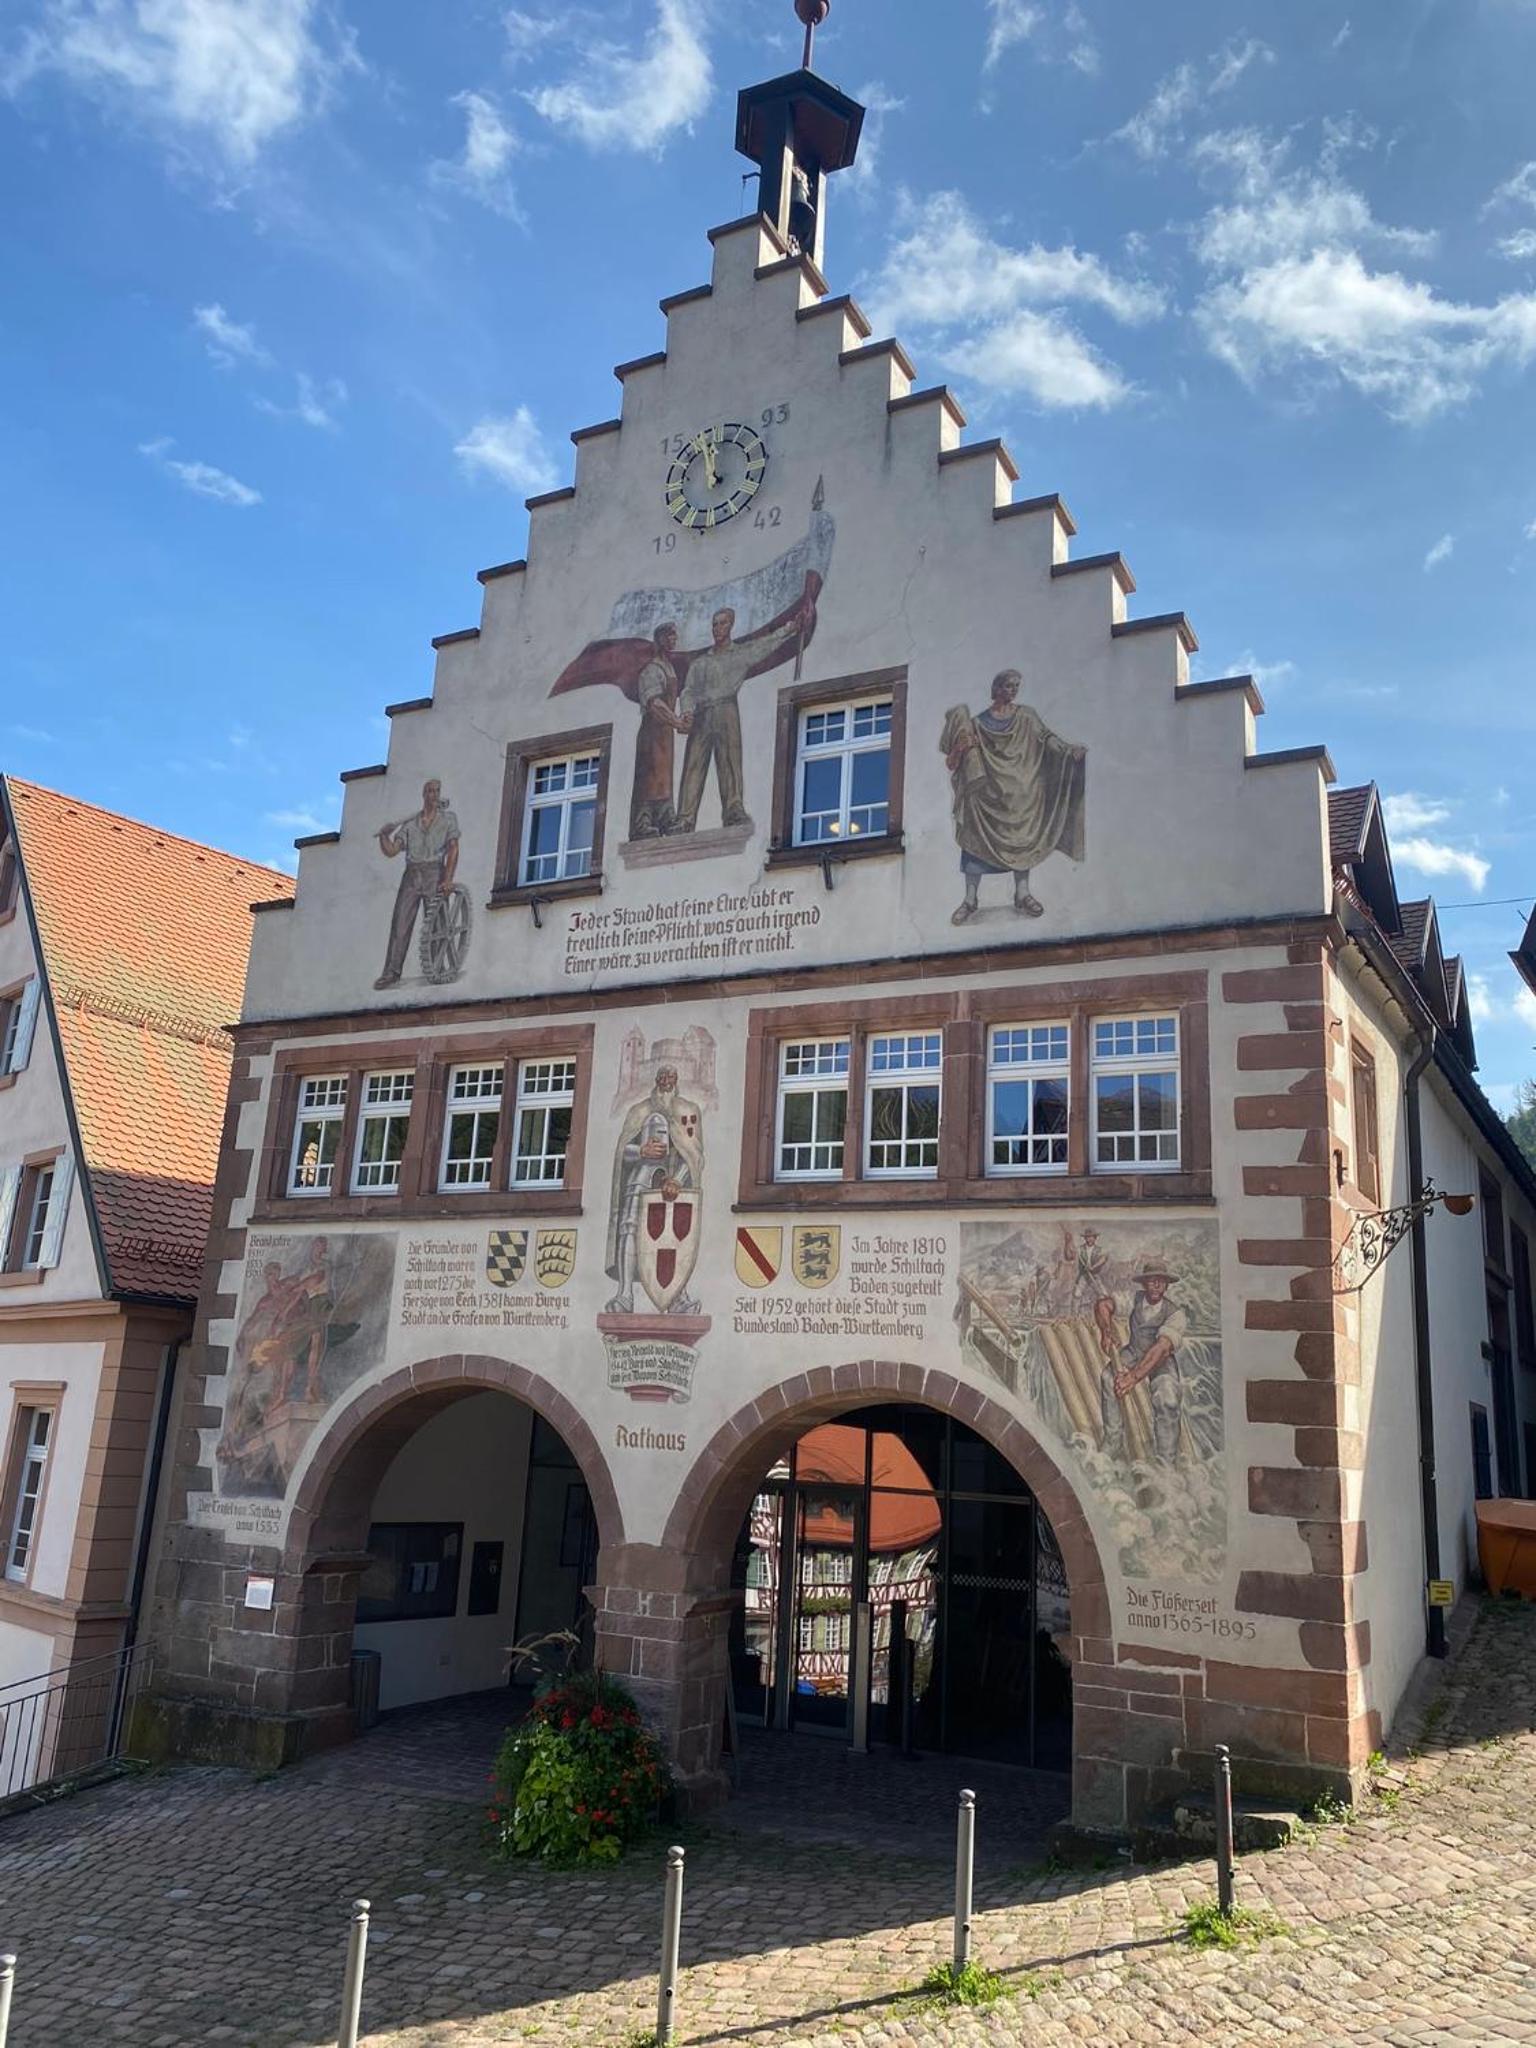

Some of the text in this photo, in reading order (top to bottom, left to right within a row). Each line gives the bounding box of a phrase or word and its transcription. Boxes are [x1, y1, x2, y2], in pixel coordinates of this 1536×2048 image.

[659, 403, 791, 455] 15 93
[652, 506, 782, 555] 19 42
[568, 912, 611, 932] Jeder
[612, 904, 654, 926] Stand
[656, 900, 680, 920] hat
[751, 888, 778, 908] übt
[779, 890, 795, 906] er
[566, 931, 620, 952] treulich
[704, 920, 735, 937] was
[736, 911, 770, 932] auch
[773, 905, 821, 930] irgend
[564, 955, 597, 974] Einer
[634, 952, 651, 968] zu
[653, 940, 720, 964] verachten
[739, 939, 753, 955] er
[755, 931, 795, 953] nicht.
[407, 1240, 421, 1255] Die
[461, 1243, 477, 1254] von
[851, 1236, 947, 1256] Im Jahre 1810
[406, 1257, 446, 1273] Schiltach
[851, 1256, 945, 1278] wurde Schiltach
[849, 1276, 943, 1298] Baden zugeteilt
[455, 1291, 477, 1307] Teck
[478, 1292, 503, 1309] 1381
[535, 1292, 562, 1310] Burg
[734, 1297, 757, 1313] Seit
[762, 1297, 793, 1316] 1952
[795, 1297, 833, 1316] gehört
[864, 1297, 899, 1315] Stadt
[901, 1302, 927, 1318] zum
[400, 1310, 426, 1325] Stadt
[452, 1310, 484, 1325] Grafen
[733, 1316, 800, 1334] Bundesland
[616, 1424, 687, 1452] Rathaus
[1126, 1585, 1220, 1614] Die Flößerzeit
[1127, 1612, 1257, 1640] anno 1365-1895
